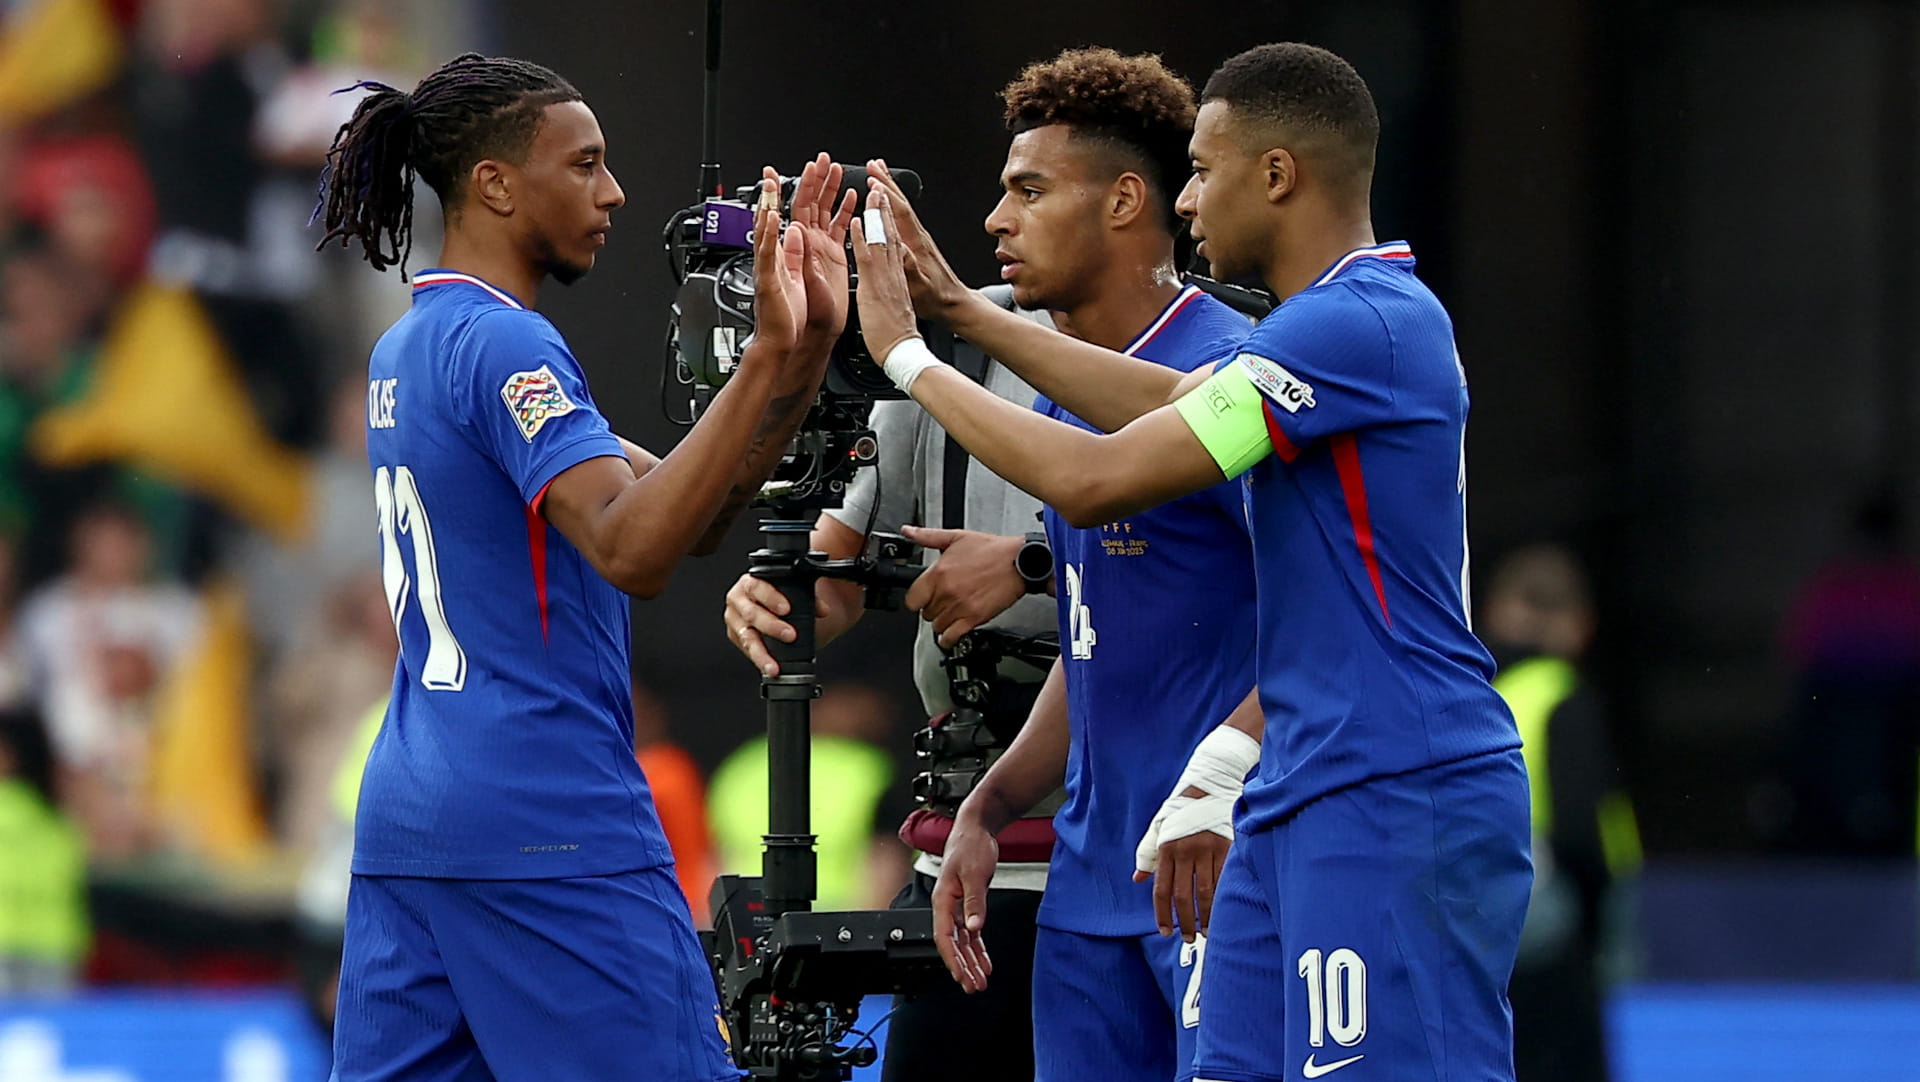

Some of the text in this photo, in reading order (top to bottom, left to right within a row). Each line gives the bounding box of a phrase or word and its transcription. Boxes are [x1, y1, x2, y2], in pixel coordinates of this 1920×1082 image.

[707, 210, 719, 234] 021
[369, 378, 398, 429] OLISE
[1066, 563, 1097, 660] 24
[1299, 948, 1367, 1048] 10
